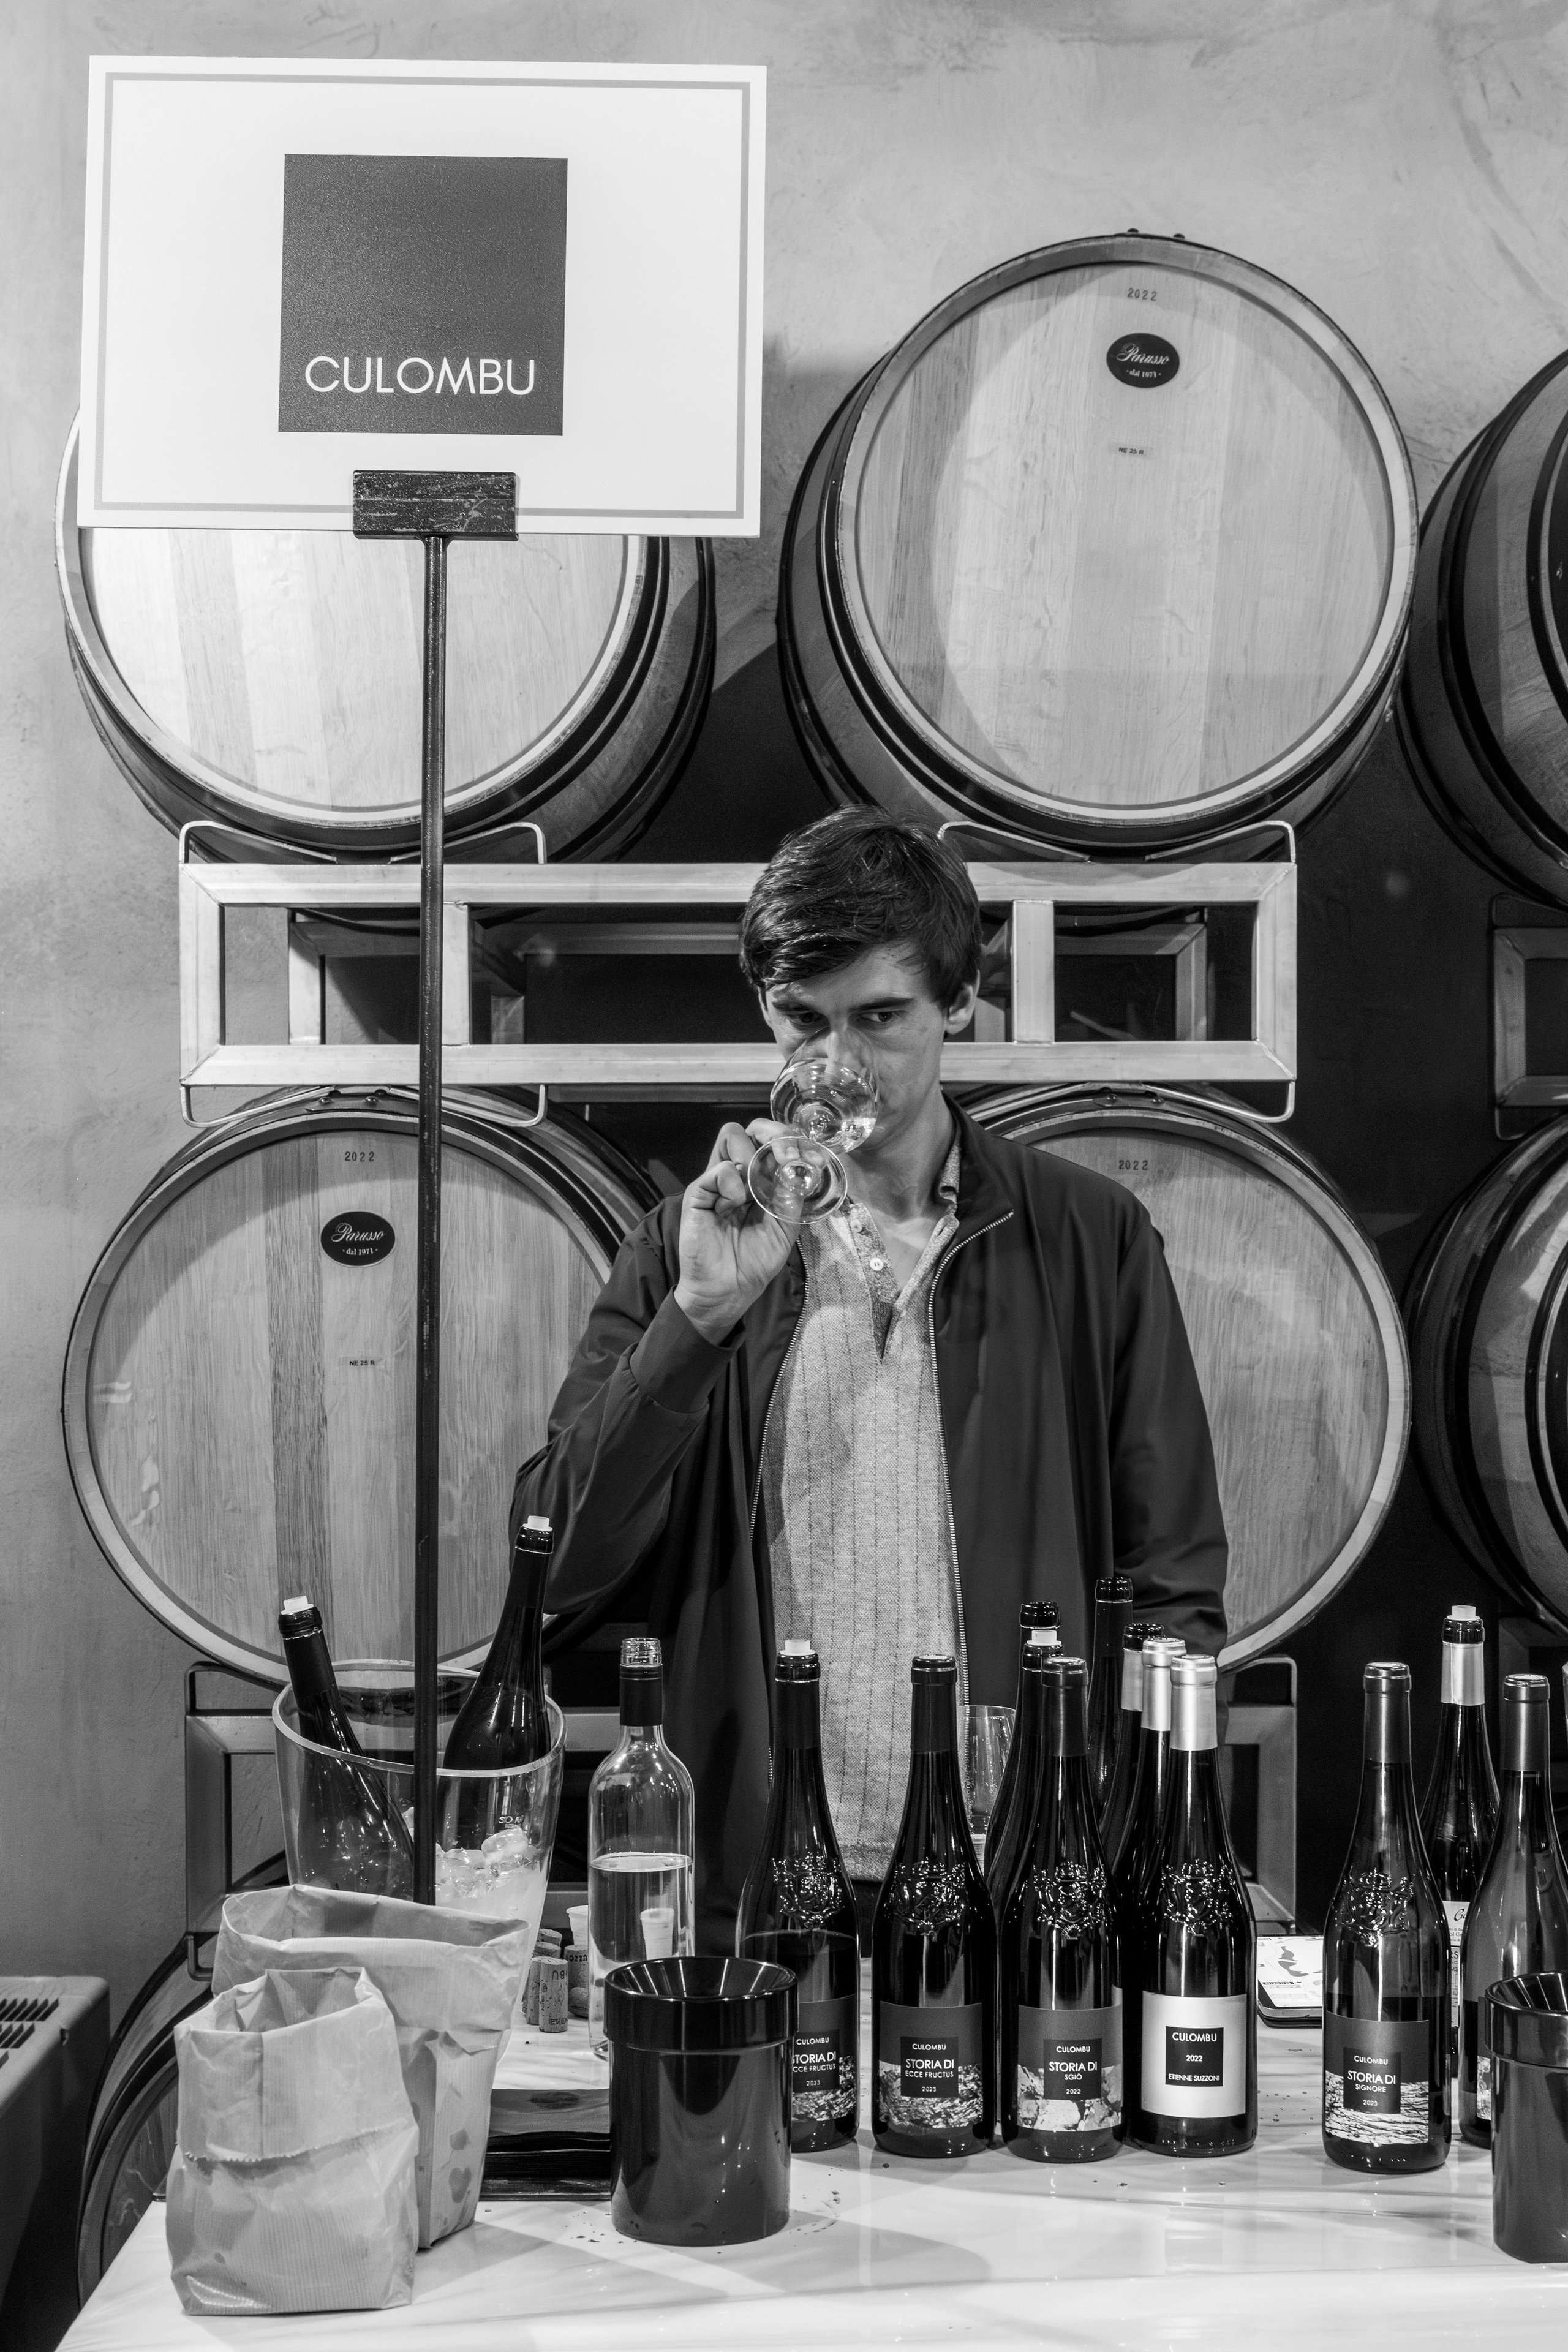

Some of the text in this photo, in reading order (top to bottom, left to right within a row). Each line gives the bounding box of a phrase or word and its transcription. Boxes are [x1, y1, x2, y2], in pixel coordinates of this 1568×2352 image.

[1127, 287, 1158, 301] 2022
[1116, 342, 1170, 365] Parusso
[305, 356, 535, 396] CULOMBU
[344, 1151, 375, 1163] 2022
[1118, 1159, 1148, 1170] 2022
[330, 1222, 385, 1242] Parusso
[358, 1248, 374, 1256] 1971
[796, 2037, 829, 2045] CULOMBU
[1171, 2032, 1217, 2042] CULOMBU
[827, 2051, 836, 2062] DI
[1354, 2055, 1389, 2065] CULOMBU
[809, 2062, 836, 2072] FRUCTUS
[906, 2058, 954, 2070] STORIA DI
[1049, 2061, 1098, 2072] STORIA DI
[1347, 2070, 1396, 2084] STORIA DI
[1355, 2083, 1387, 2093] SIGNORE
